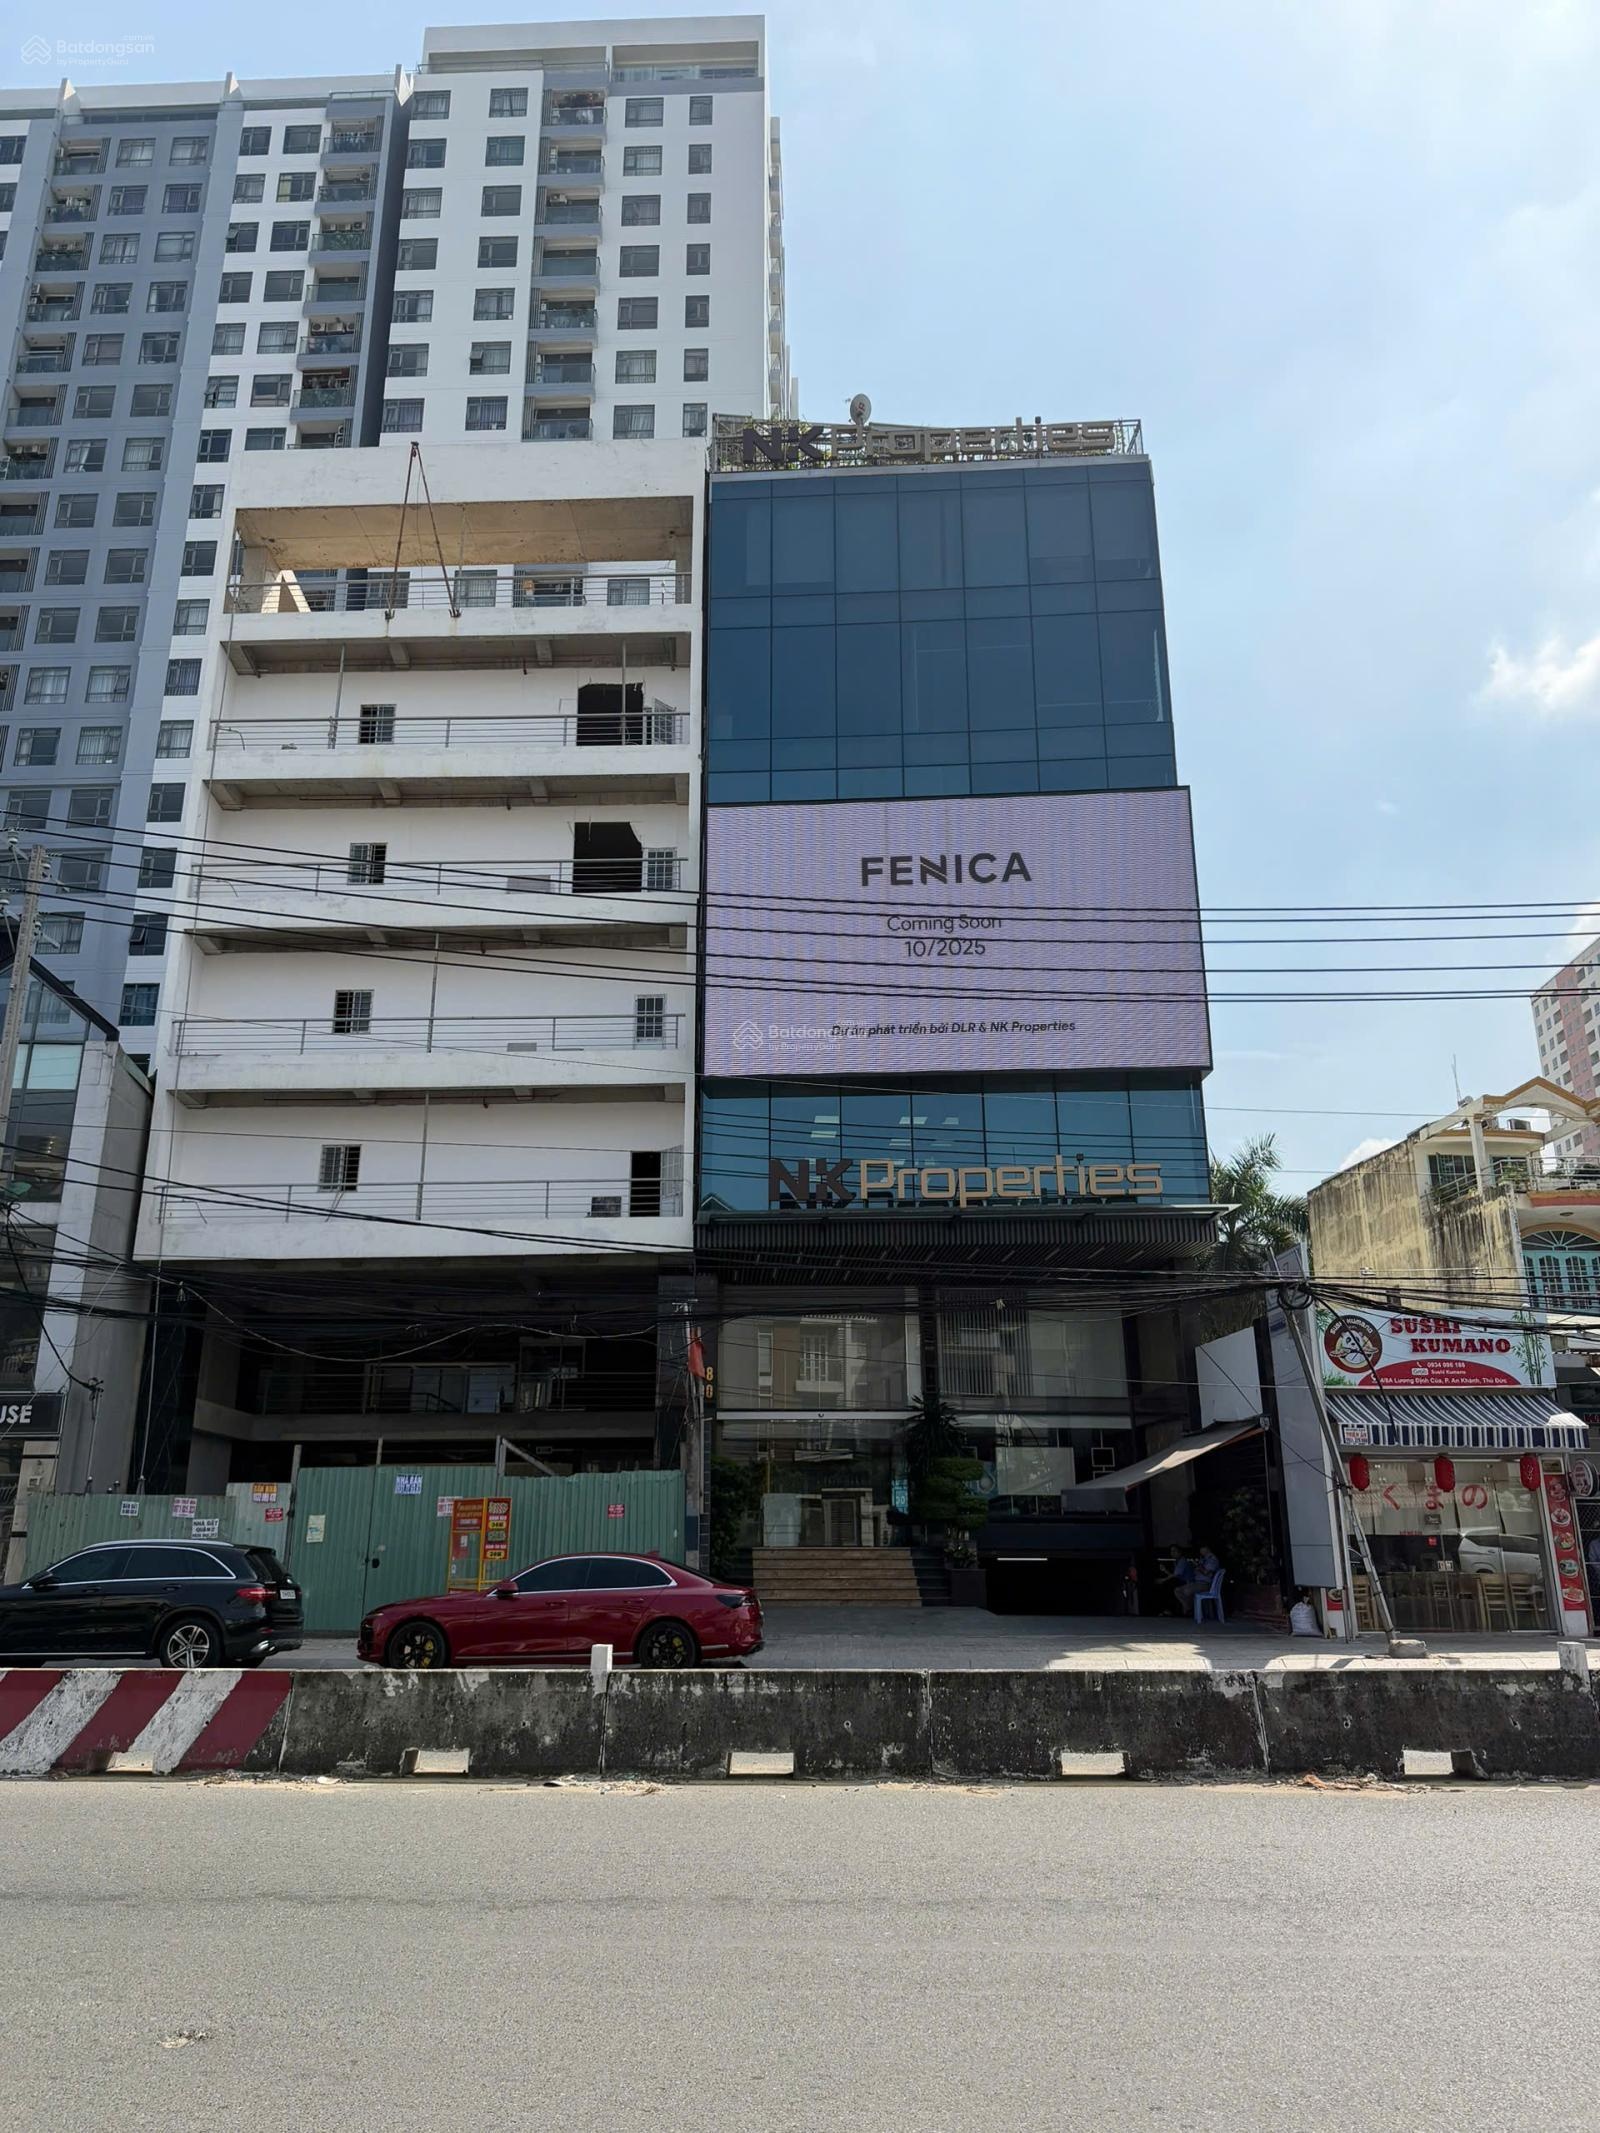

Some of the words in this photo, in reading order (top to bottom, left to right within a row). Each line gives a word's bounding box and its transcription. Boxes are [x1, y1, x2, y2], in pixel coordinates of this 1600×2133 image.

[743, 425, 824, 464] NK
[861, 852, 1032, 886] FENICA
[887, 915, 954, 933] Coming
[959, 914, 1002, 929] Soon
[905, 939, 986, 957] 10/2025
[867, 1023, 895, 1037] phát
[951, 1022, 976, 1033] DLR
[979, 1022, 987, 1033] &
[990, 1021, 1008, 1032] NK
[1011, 1020, 1076, 1034] Properties
[769, 1158, 856, 1209] NK
[860, 1153, 1163, 1208] Properties
[1390, 1317, 1462, 1334] SUSHI
[1410, 1338, 1511, 1353] KUMANO
